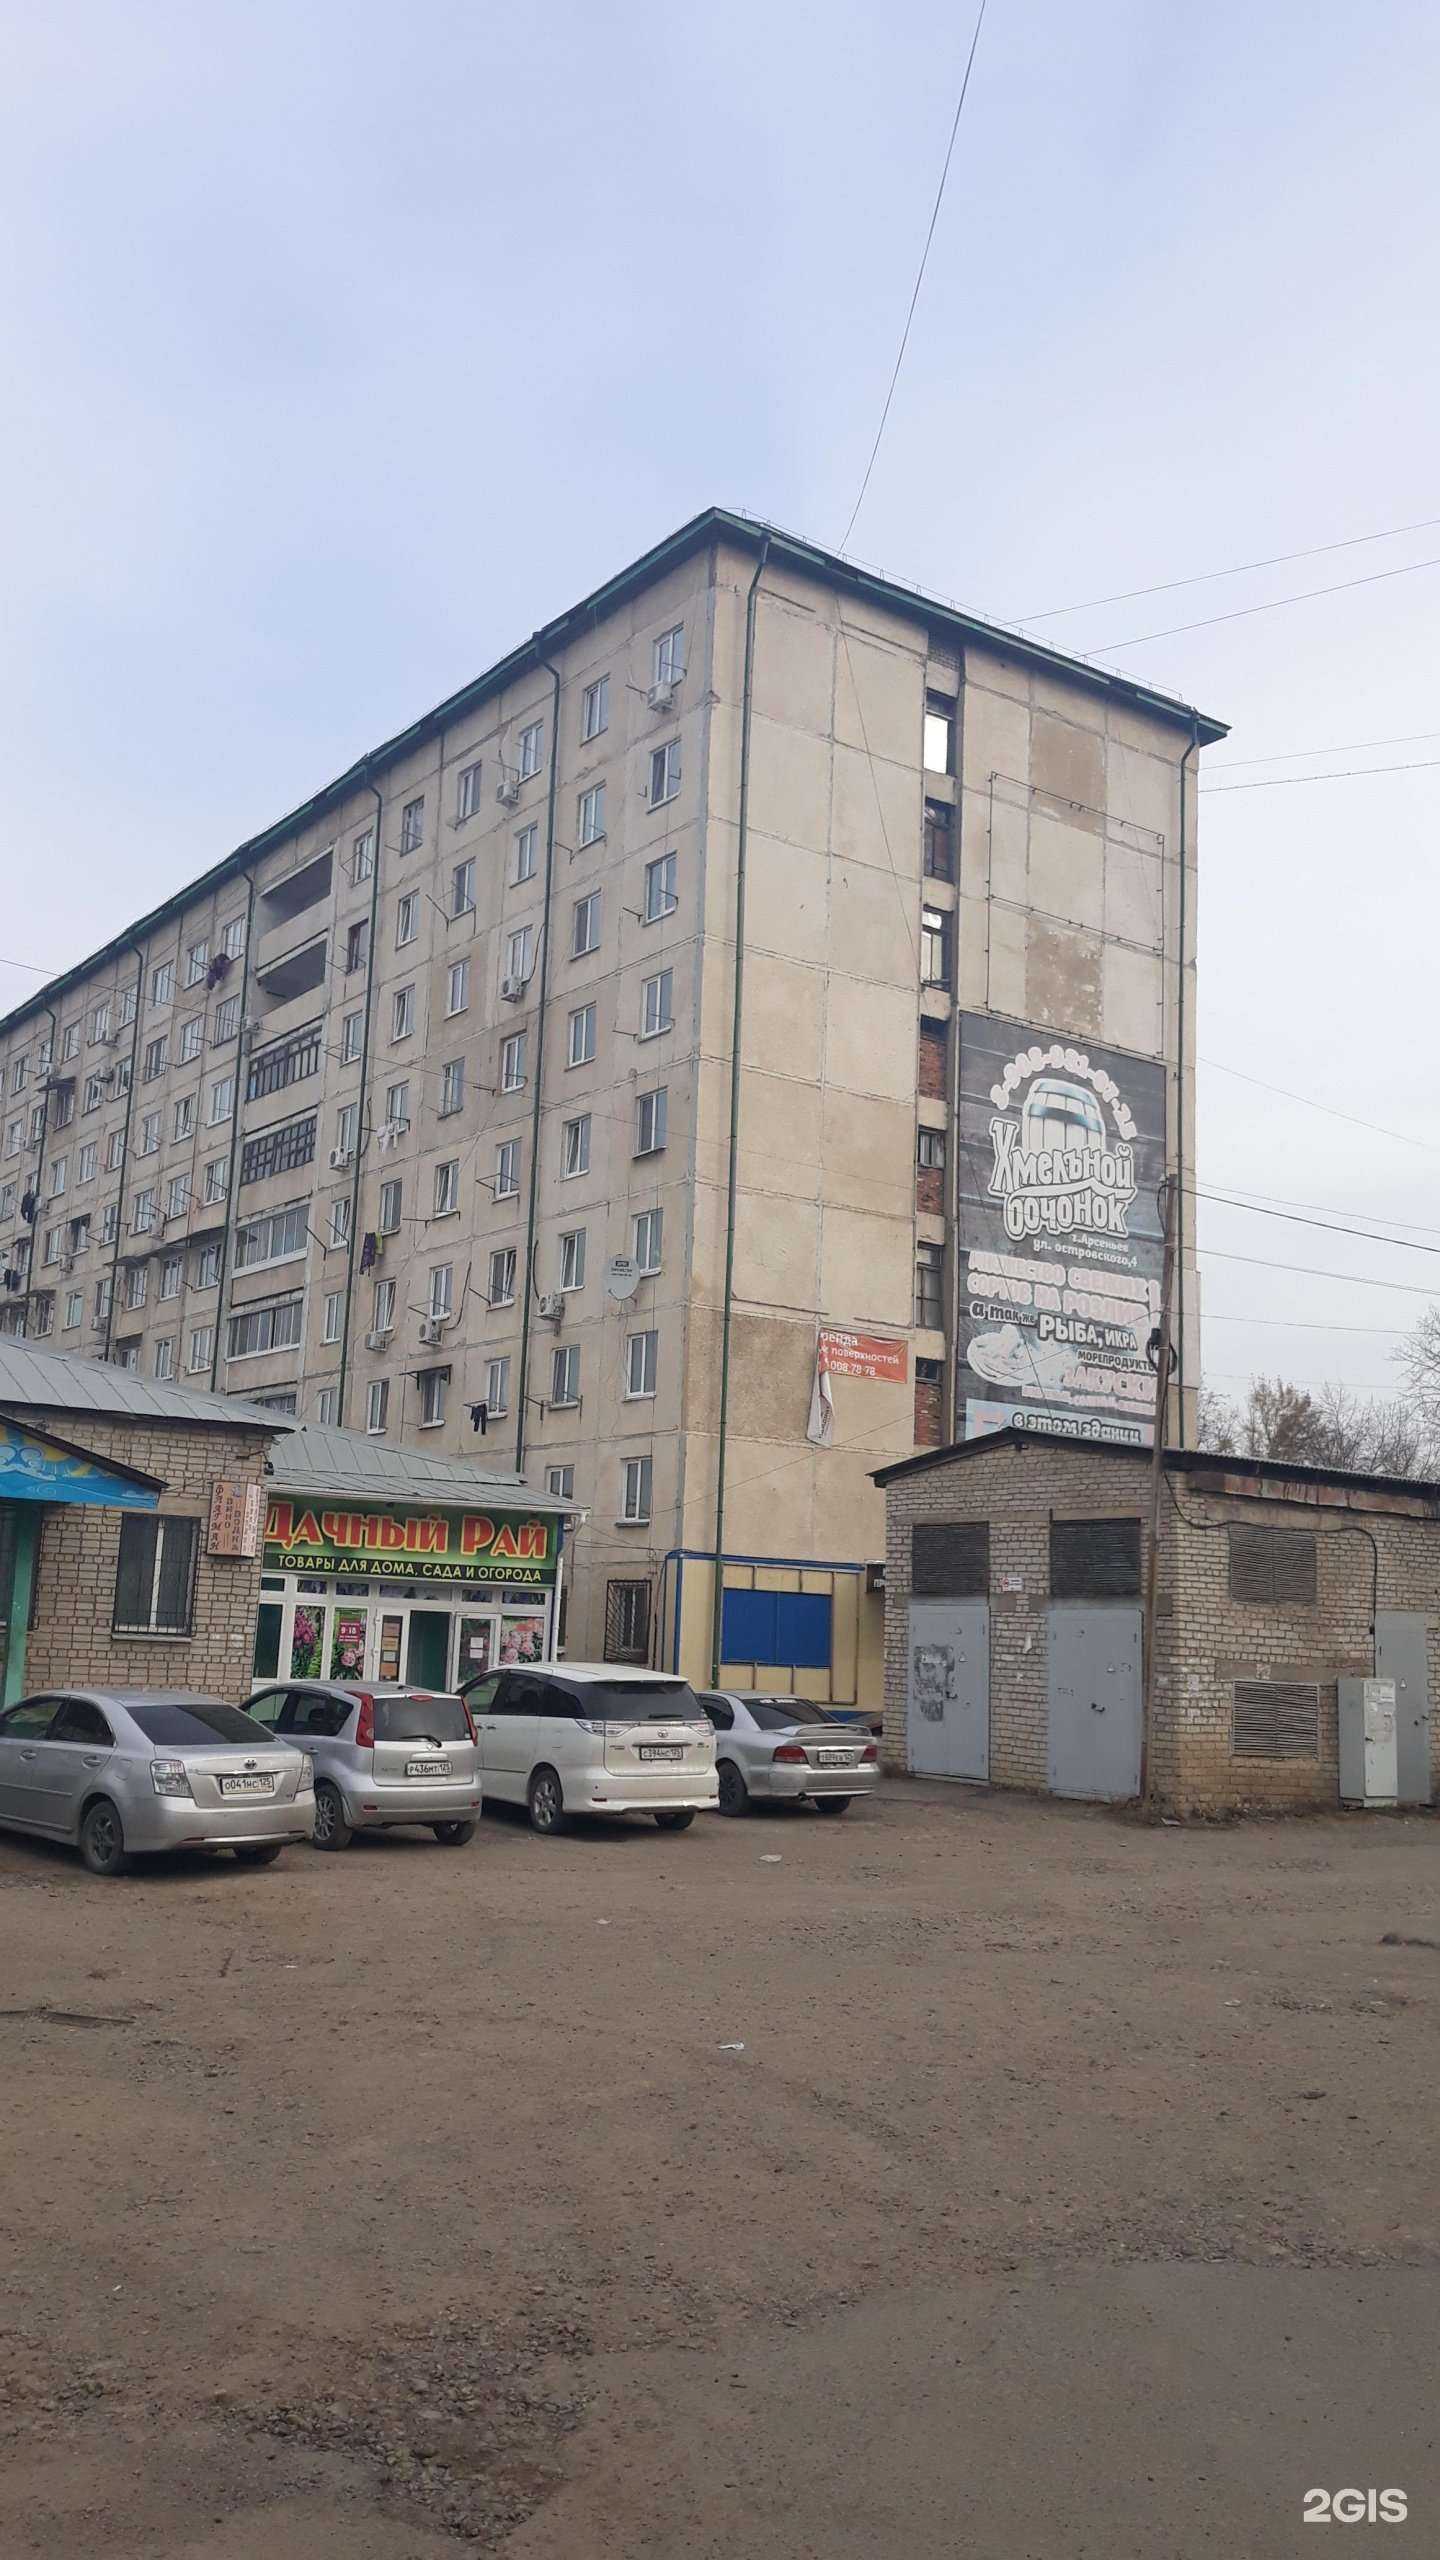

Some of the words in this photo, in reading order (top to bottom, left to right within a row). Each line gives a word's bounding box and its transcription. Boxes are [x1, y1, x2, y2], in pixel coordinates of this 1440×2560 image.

[989, 1118, 1135, 1195] Хмельной
[1006, 1190, 1128, 1239] бочонок
[1105, 1328, 1138, 1350] ИКРА
[831, 1347, 899, 1365] поверхностей
[1080, 1418, 1142, 1443] здании
[278, 1554, 335, 1571] ТОВАРЫ
[338, 1557, 368, 1573] ДЛЯ
[370, 1560, 419, 1577] ДОМА,
[422, 1563, 462, 1579] САДА
[465, 1564, 476, 1579] И
[478, 1566, 543, 1582] ОГОРОДА
